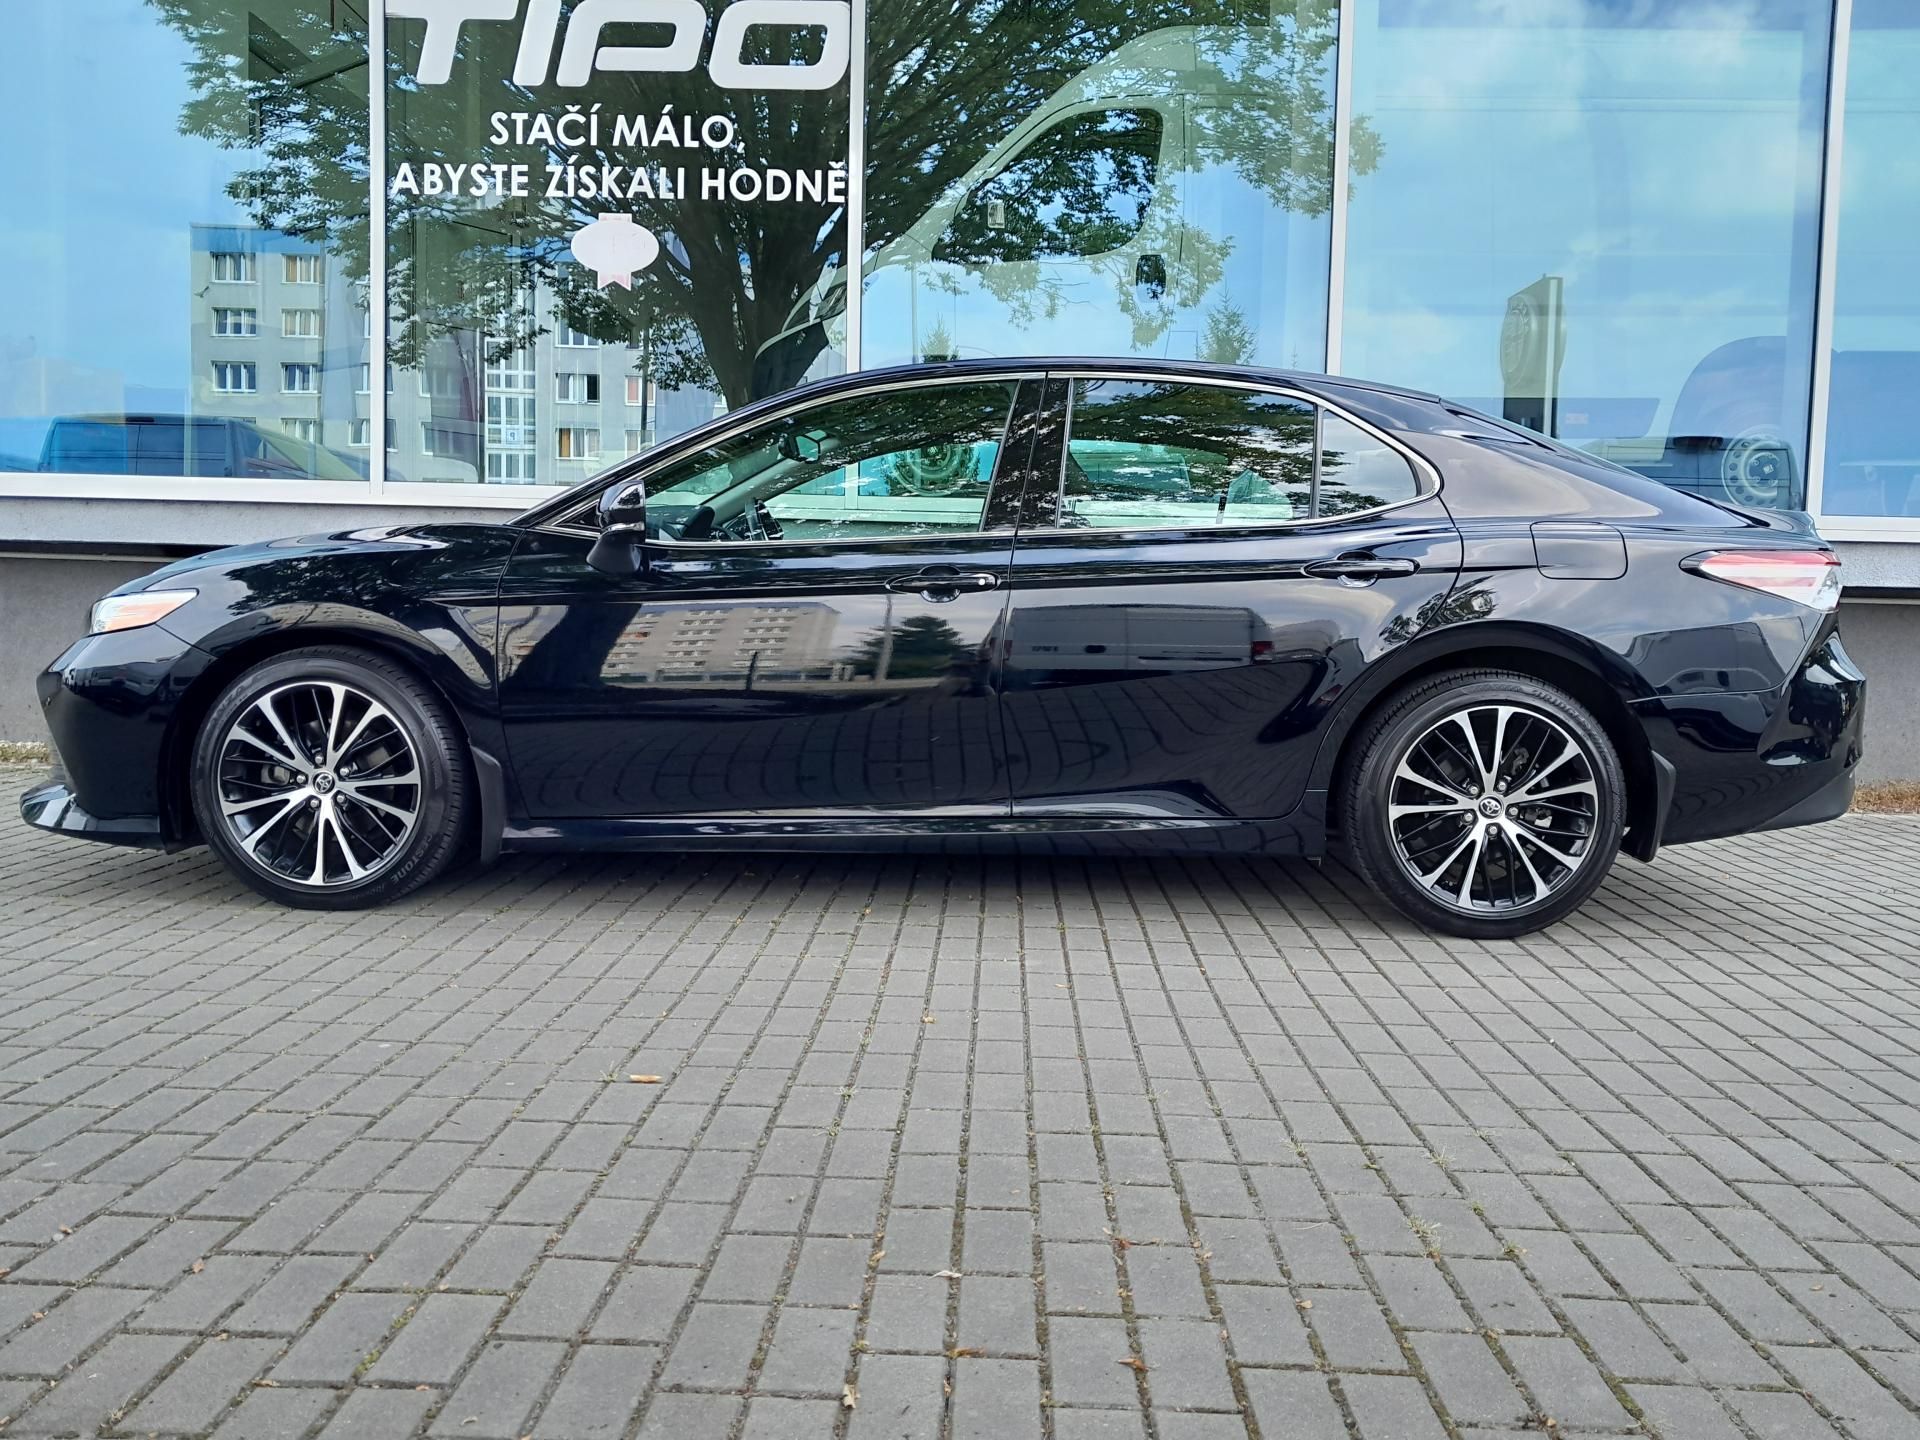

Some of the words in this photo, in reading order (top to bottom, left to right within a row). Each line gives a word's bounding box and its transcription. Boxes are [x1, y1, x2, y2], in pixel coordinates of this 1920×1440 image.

[385, 0, 851, 90] TIPO
[490, 104, 603, 147] STAČÍ
[613, 104, 745, 153] MÁLO,
[391, 162, 529, 197] ABYSTE
[545, 155, 685, 200] ZÍSKALI
[701, 161, 846, 203] HODNĚ
